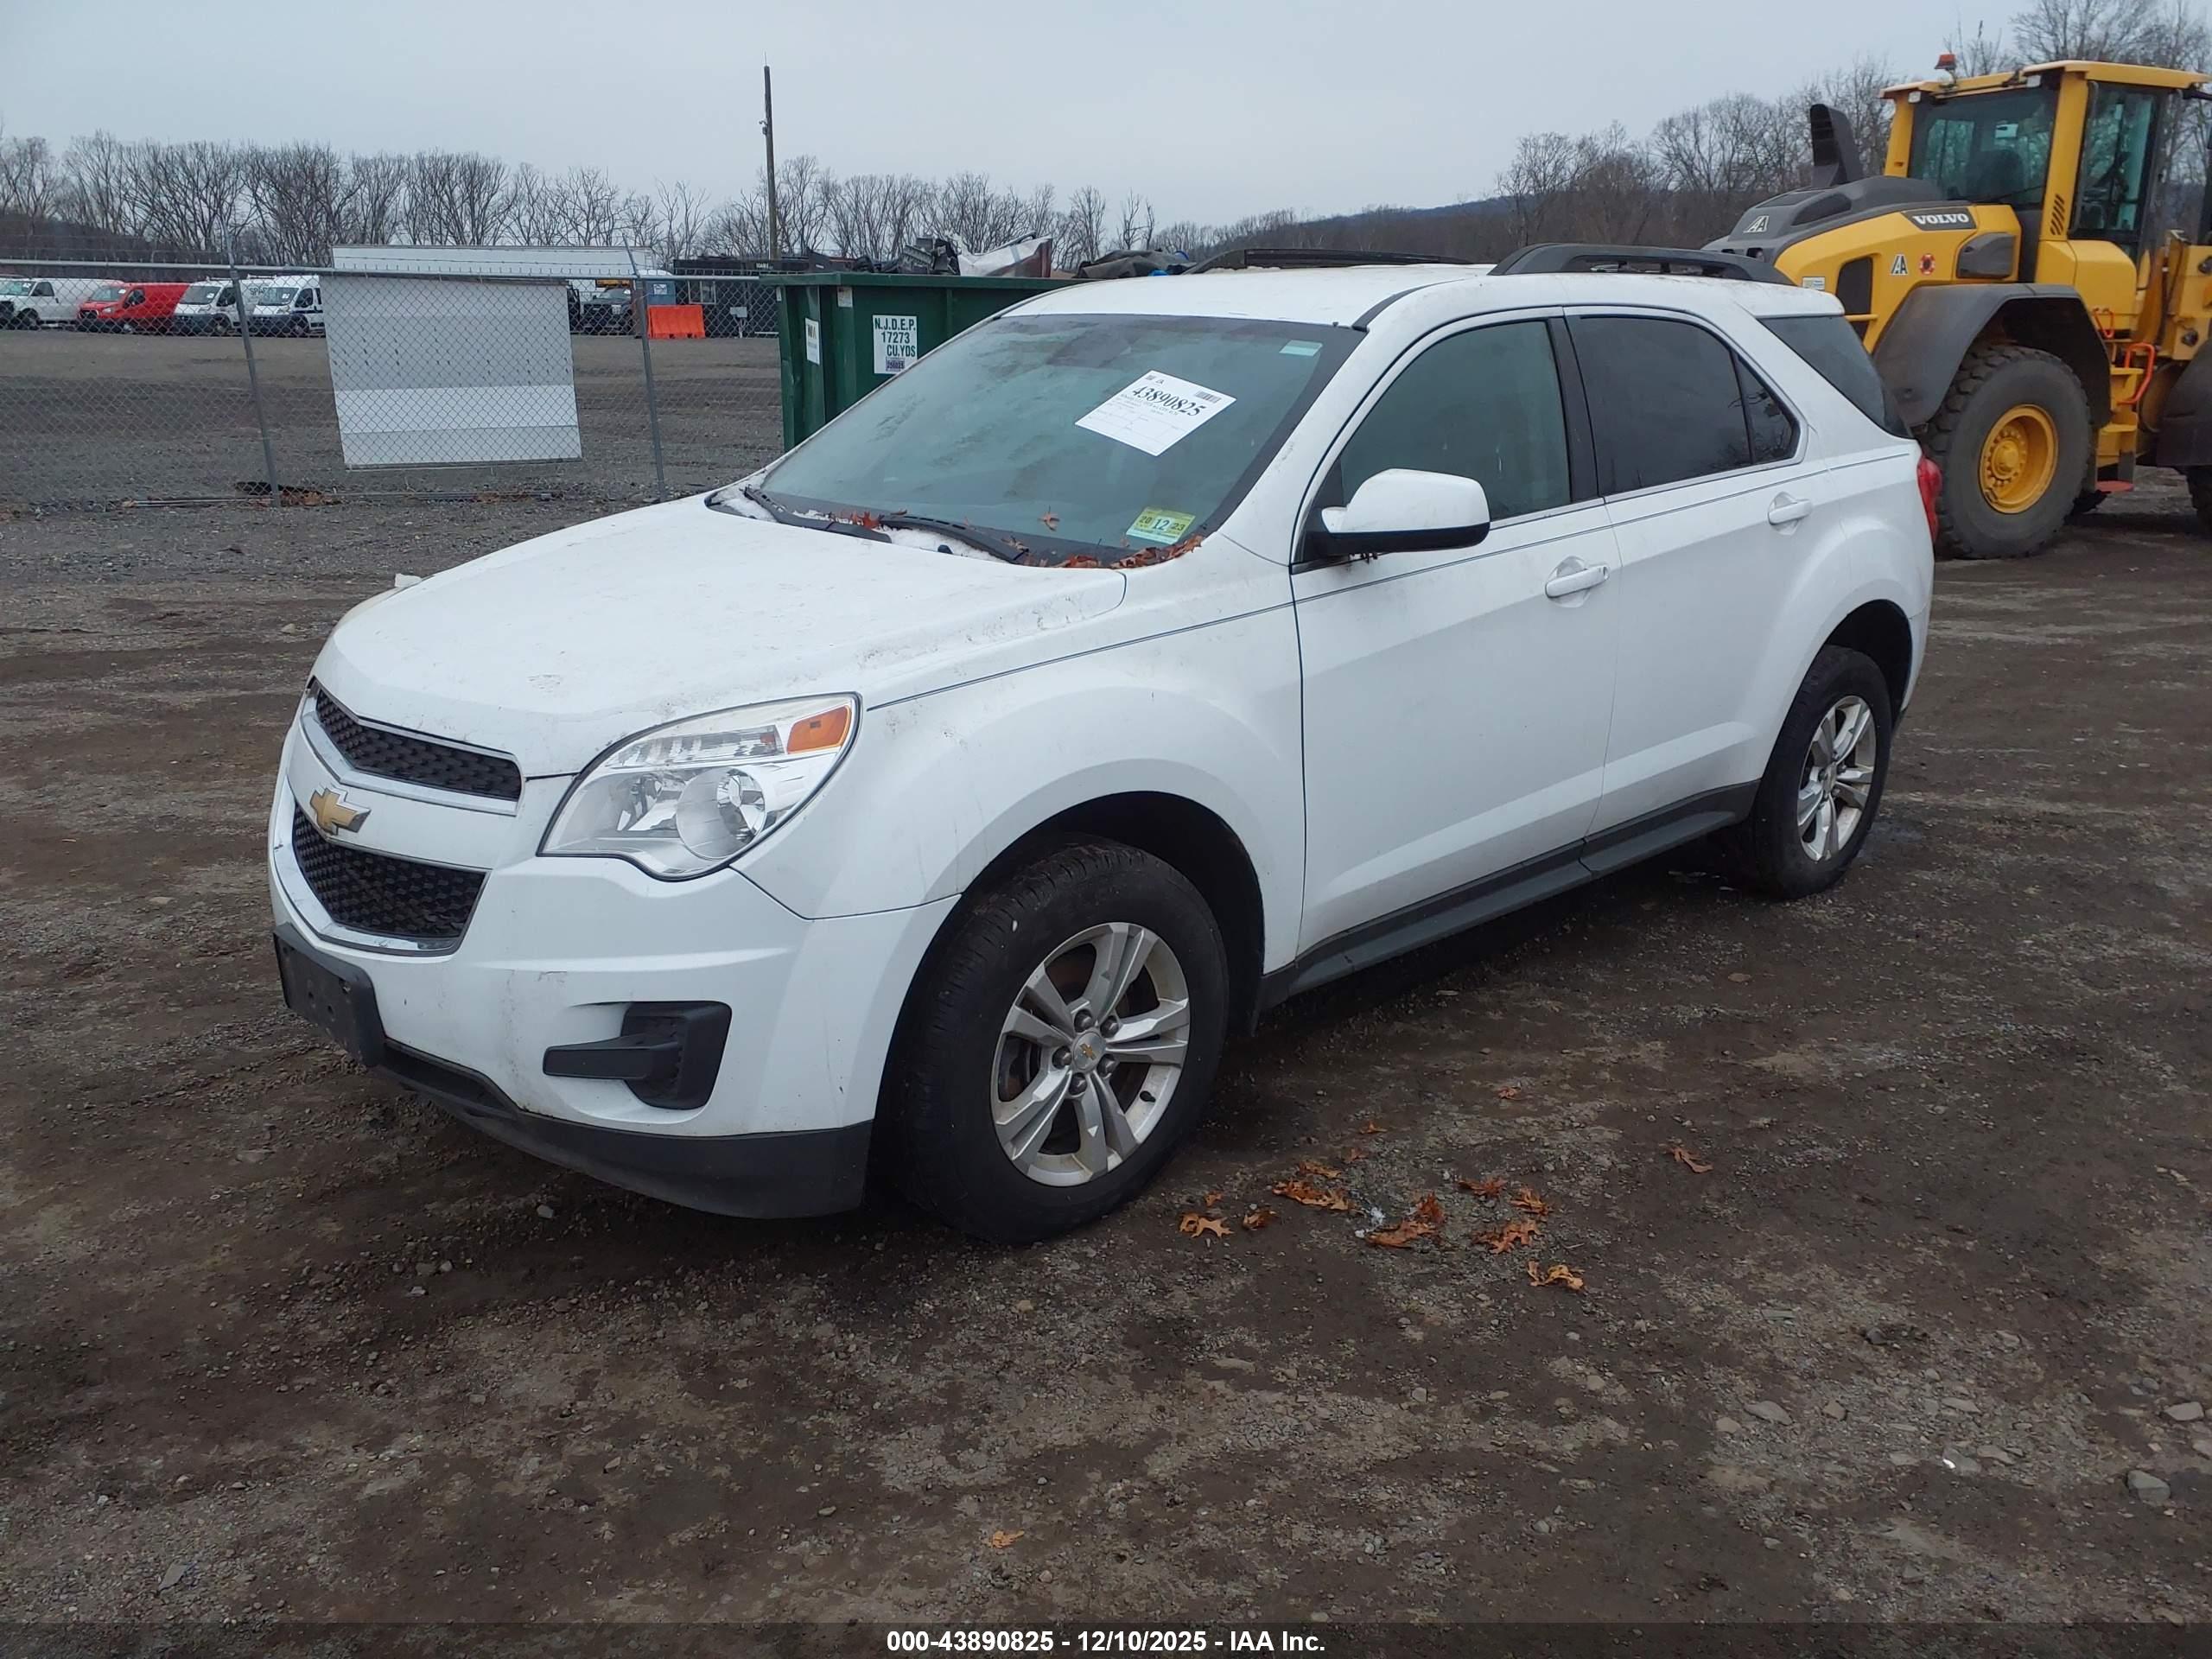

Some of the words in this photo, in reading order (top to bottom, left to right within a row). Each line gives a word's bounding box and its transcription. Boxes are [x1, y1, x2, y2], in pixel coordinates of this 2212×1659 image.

[1912, 213, 1969, 225] VOLVO
[874, 317, 916, 331] N.J.D.E.P.
[880, 331, 911, 344] 17273
[1132, 385, 1207, 416] 43890825
[1152, 518, 1171, 531] 12
